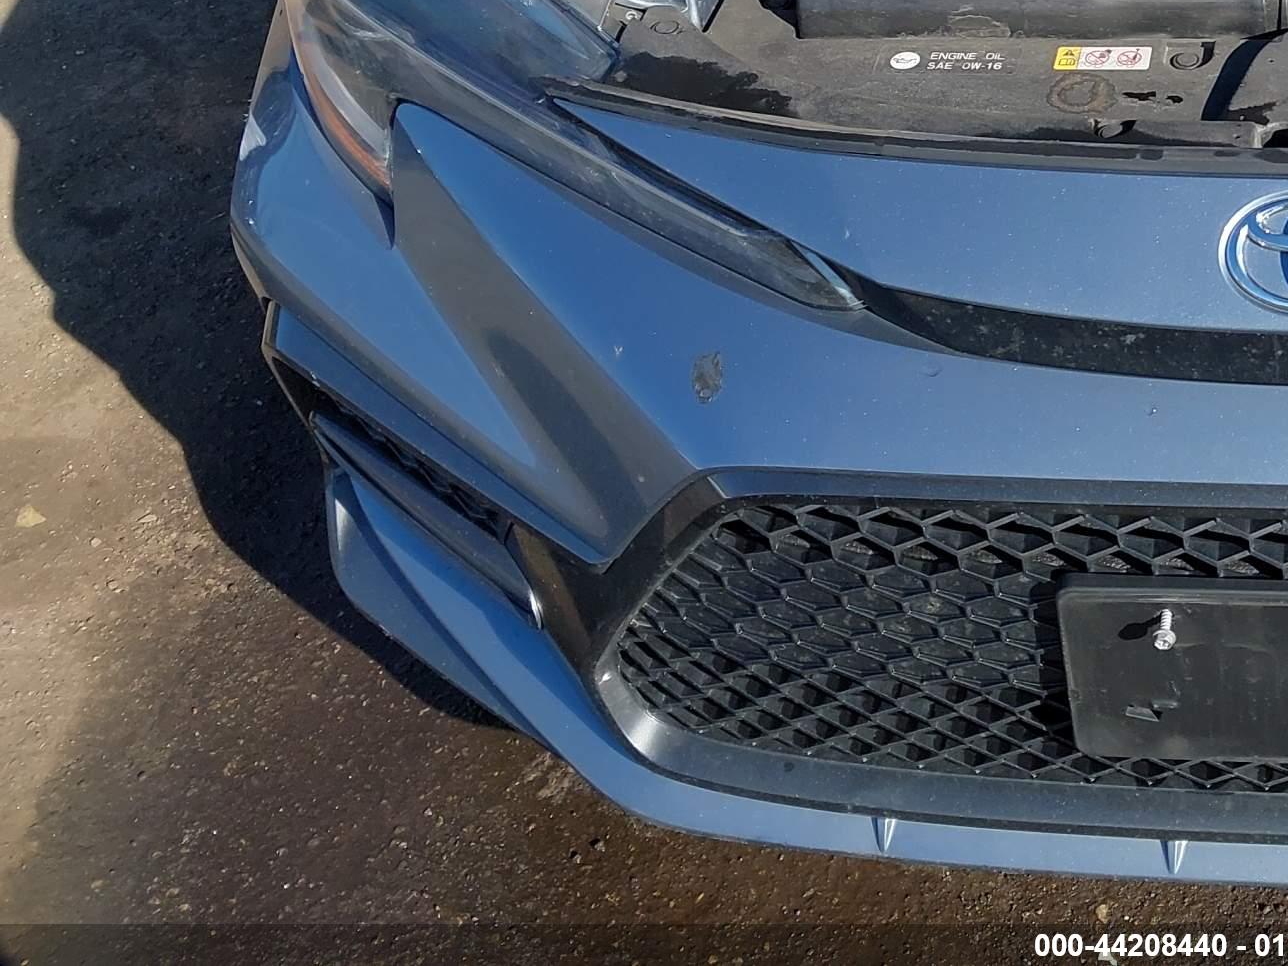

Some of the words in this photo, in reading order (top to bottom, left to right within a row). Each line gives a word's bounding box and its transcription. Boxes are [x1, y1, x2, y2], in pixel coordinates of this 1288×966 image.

[930, 52, 977, 60] ENGINE
[985, 52, 1005, 60] OIL
[926, 62, 953, 70] SAE
[961, 62, 1003, 70] 0W-16
